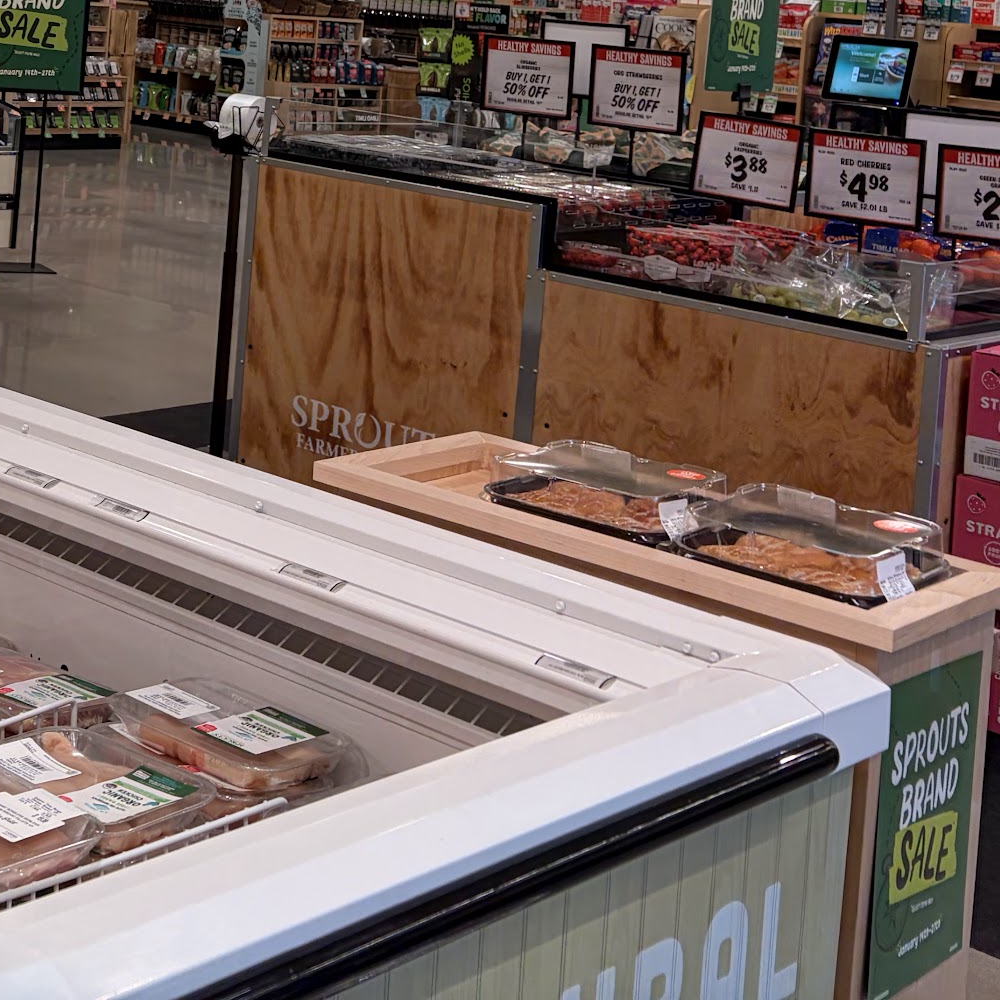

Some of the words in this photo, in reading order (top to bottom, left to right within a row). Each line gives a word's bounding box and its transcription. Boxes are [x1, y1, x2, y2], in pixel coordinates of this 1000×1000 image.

[475, 12, 507, 25] FLAVOR
[731, 21, 758, 55] SALE
[497, 40, 529, 53] HEALTHY
[530, 43, 562, 56] SAVINGS
[606, 50, 639, 64] HEALTHY
[639, 54, 673, 68] SAVINGS
[505, 71, 523, 82] BUY
[529, 73, 547, 85] GET
[626, 71, 663, 81] STRAWBERRIES
[503, 82, 527, 97] 50%
[528, 85, 551, 100] OFF
[613, 83, 632, 94] BUY
[638, 86, 657, 98] GET
[611, 95, 636, 110] 50%
[637, 98, 661, 114] OFF
[714, 118, 751, 134] HEALTHY
[752, 124, 788, 141] SAVINGS
[739, 141, 759, 150] ORGANIC
[826, 135, 866, 151] HEALTHY
[868, 140, 909, 156] SAVINGS
[840, 158, 855, 166] RED
[857, 160, 892, 172] CHERRIES
[957, 151, 1000, 169] HEALTHY
[731, 182, 746, 191] SAVE
[841, 200, 857, 209] SAVE
[860, 203, 877, 212] $2.01
[879, 205, 888, 213] LB
[975, 220, 994, 230] SAVE
[891, 701, 970, 787] SPROUTS
[103, 789, 142, 808] ORGANIC
[899, 757, 959, 833] BRAND
[895, 823, 953, 891] SALE
